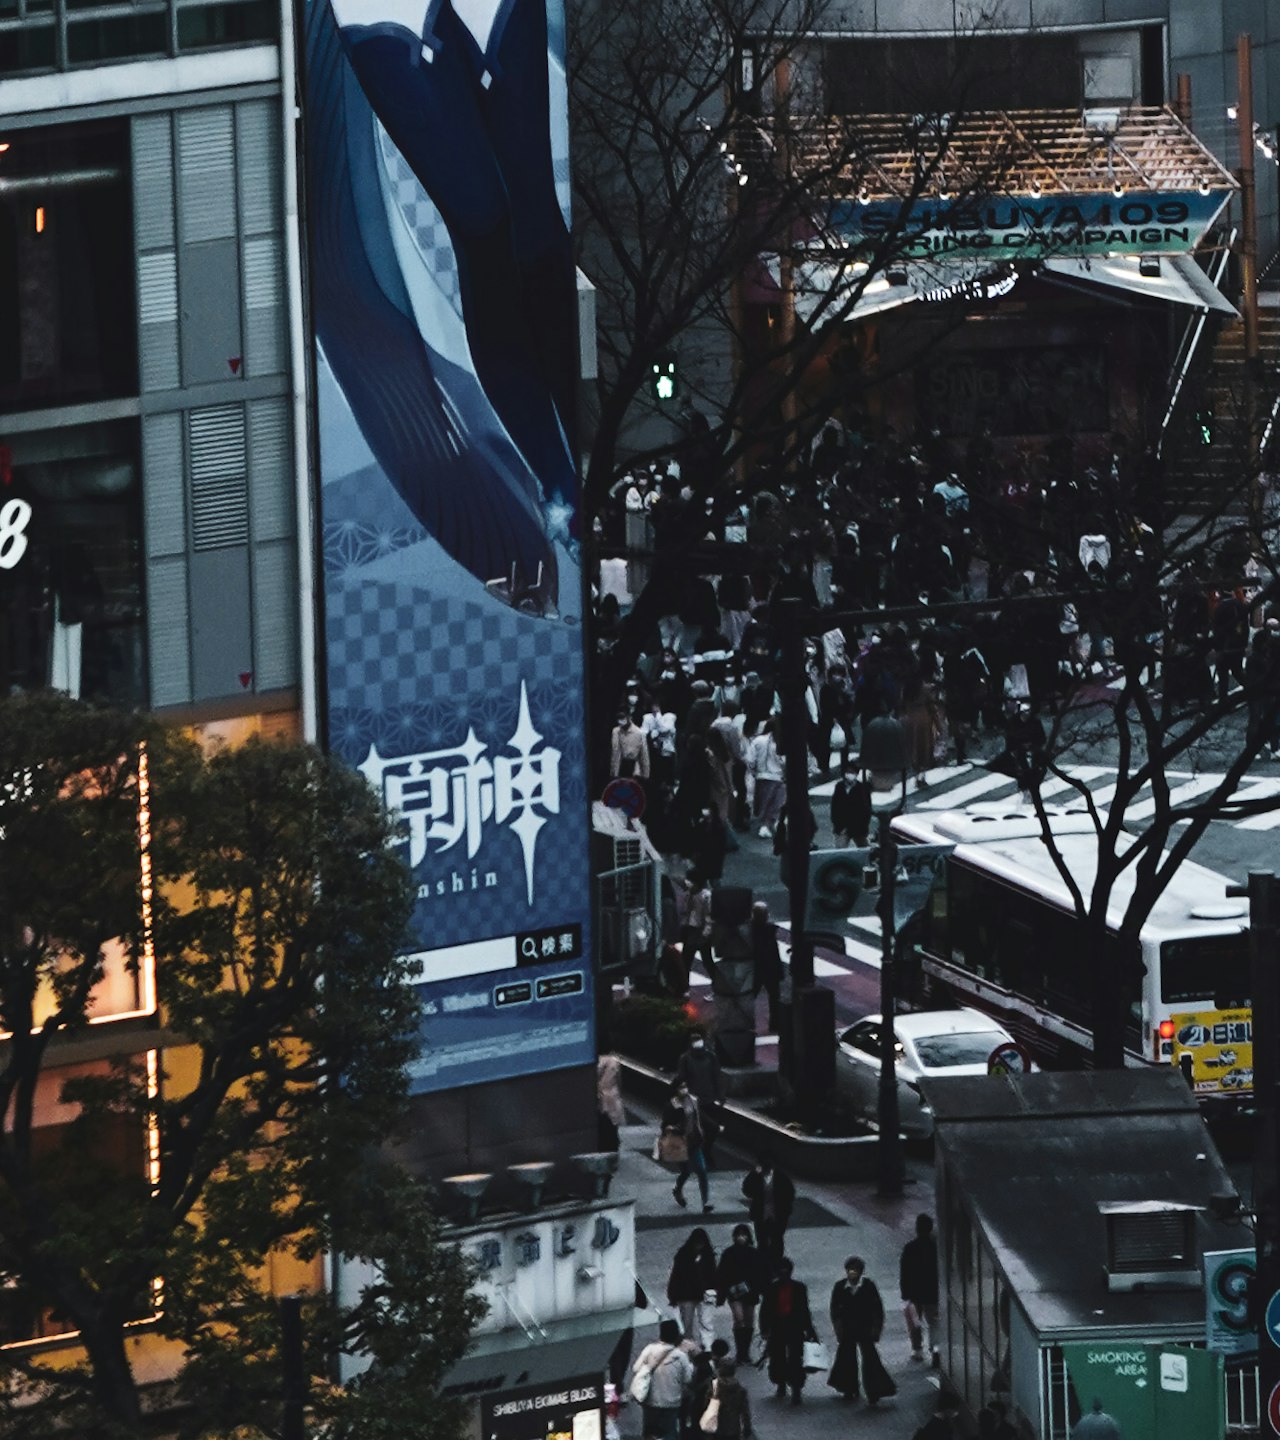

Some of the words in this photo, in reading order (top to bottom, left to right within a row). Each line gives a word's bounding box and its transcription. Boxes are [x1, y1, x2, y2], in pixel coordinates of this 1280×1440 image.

[1004, 226, 1190, 249] CAMPAIGN
[1087, 1351, 1147, 1364] SMOKING
[1115, 1364, 1148, 1376] AREA
[491, 1401, 530, 1418] SHIBUYA
[531, 1394, 568, 1412] EKIMAE
